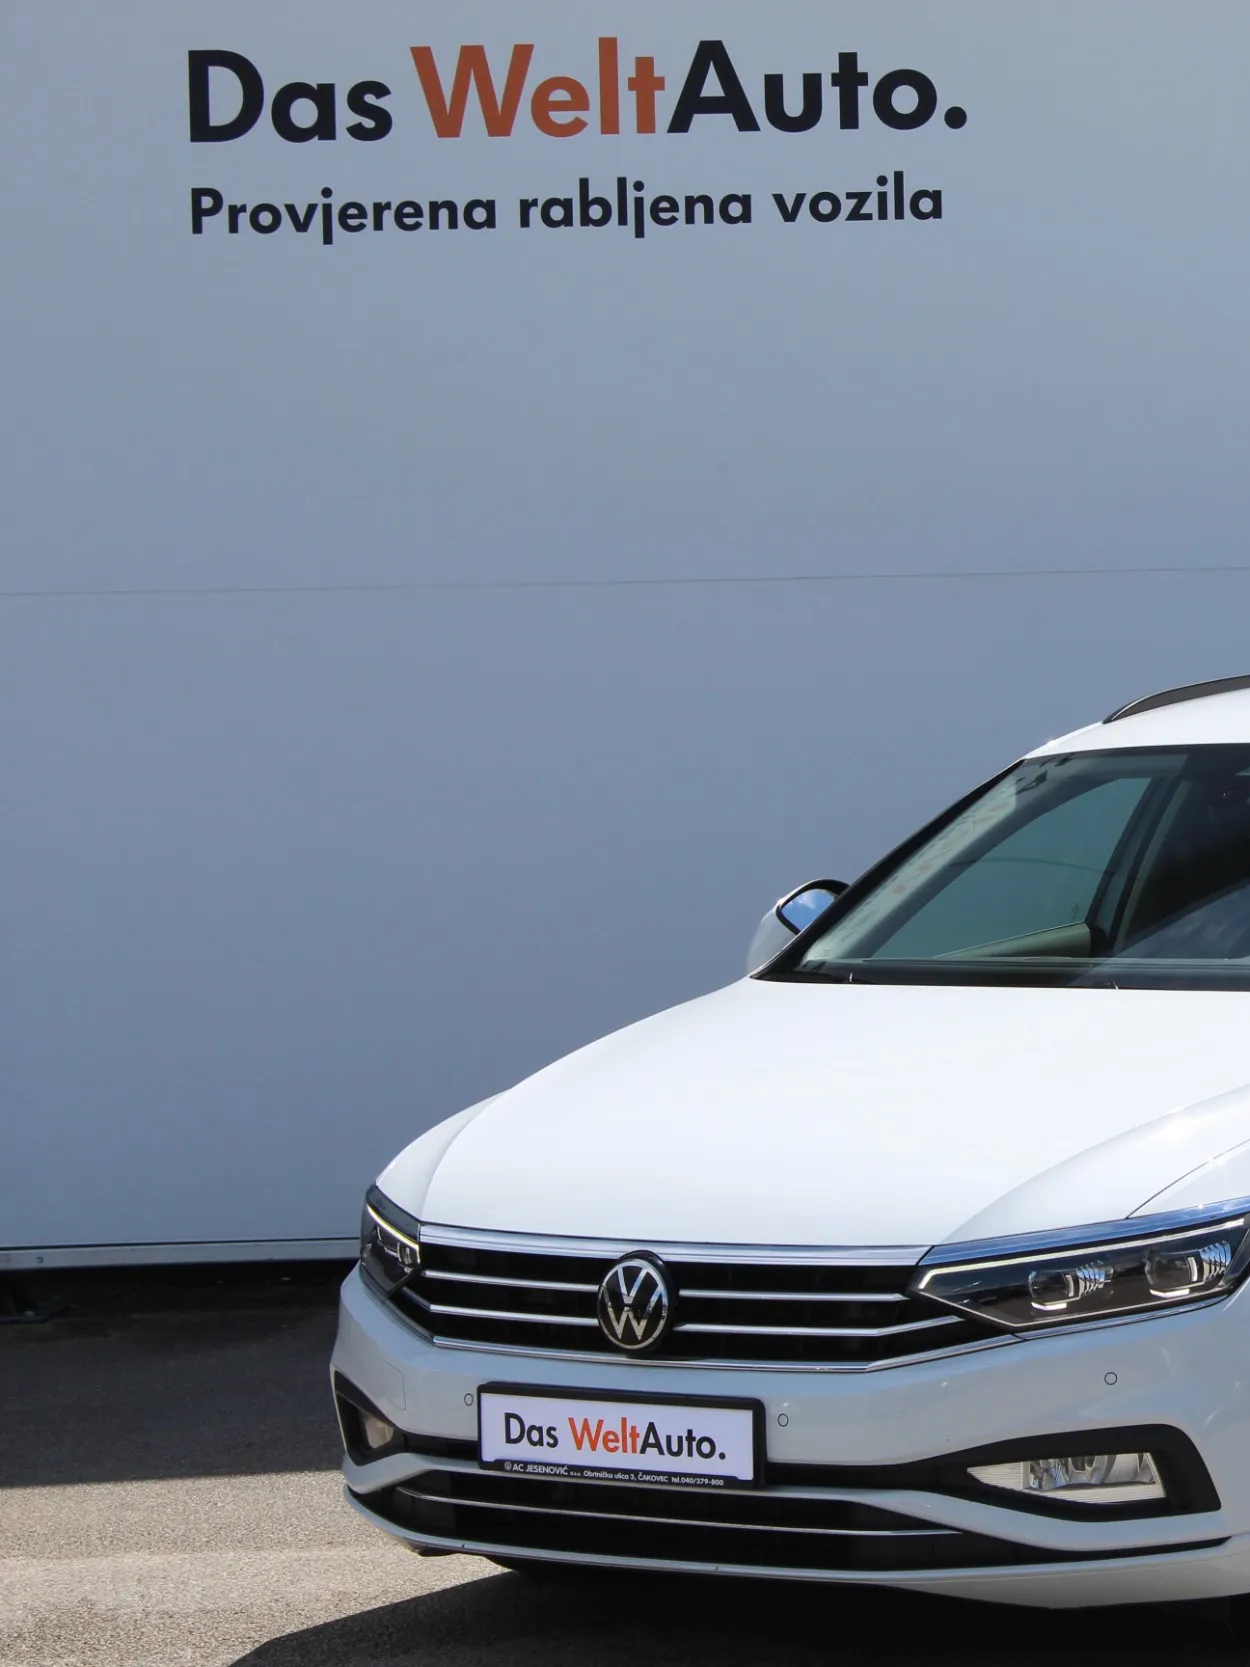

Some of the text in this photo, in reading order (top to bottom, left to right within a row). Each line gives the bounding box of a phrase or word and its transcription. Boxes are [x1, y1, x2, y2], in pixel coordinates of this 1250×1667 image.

[187, 36, 968, 144] Das WeltAuto.
[190, 170, 944, 246] Provjerena rabljena vozila
[504, 1411, 727, 1461] Das WeltAuto.
[512, 1463, 524, 1472] AC
[525, 1463, 569, 1476] JESENOVIĆ
[583, 1470, 613, 1479] Obrtnička
[614, 1472, 629, 1480] ulica
[638, 1472, 669, 1483] ČAKOVEC
